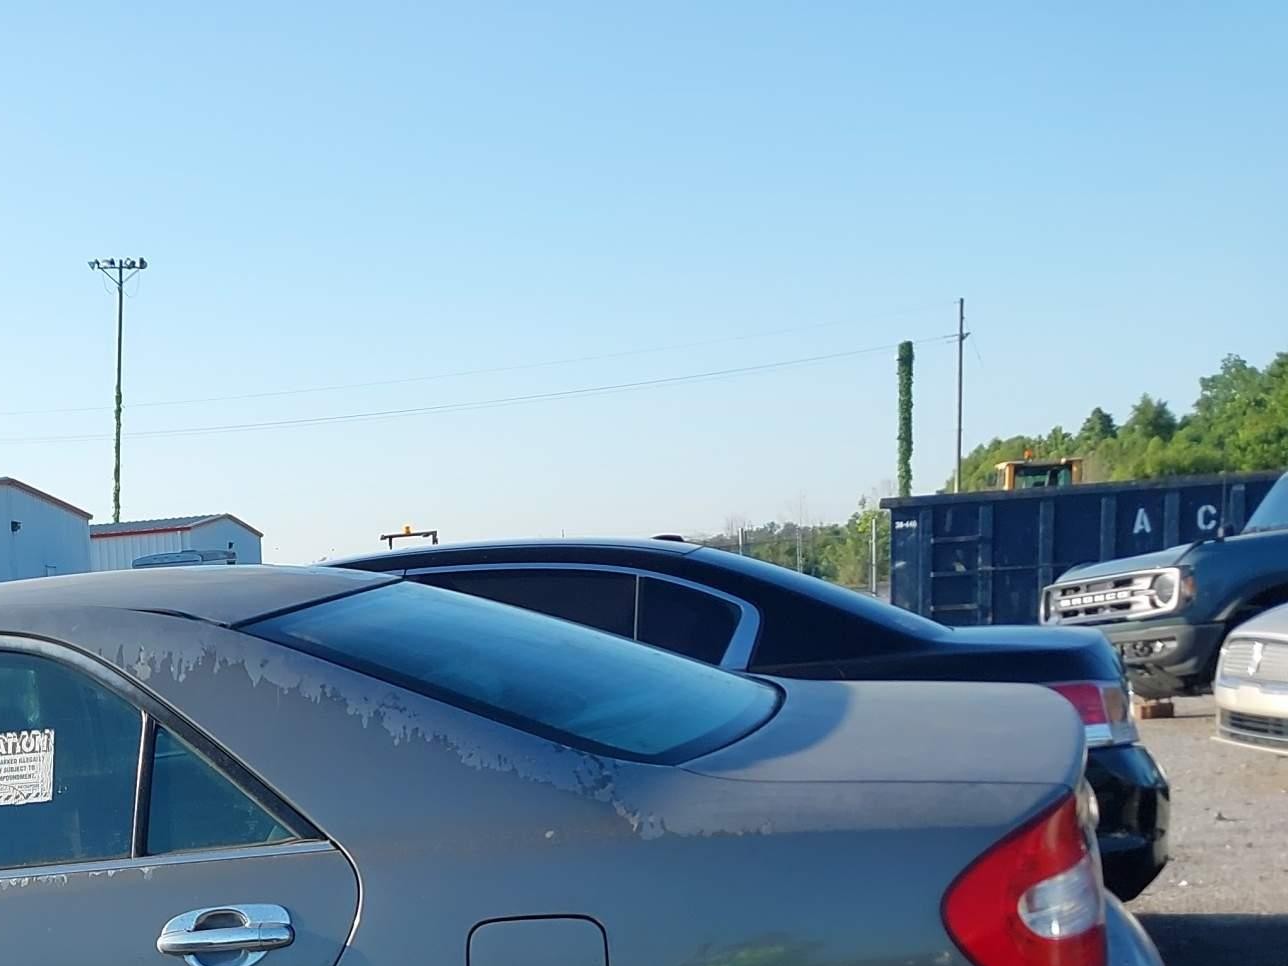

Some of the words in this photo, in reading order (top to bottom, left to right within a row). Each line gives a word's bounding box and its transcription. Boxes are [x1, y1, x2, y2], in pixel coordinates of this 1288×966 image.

[1132, 507, 1152, 534] A
[1196, 504, 1217, 531] C
[1060, 591, 1128, 607] BRONCO
[19, 755, 45, 764] ILLEGALLY
[3, 765, 26, 773] SUBJECT
